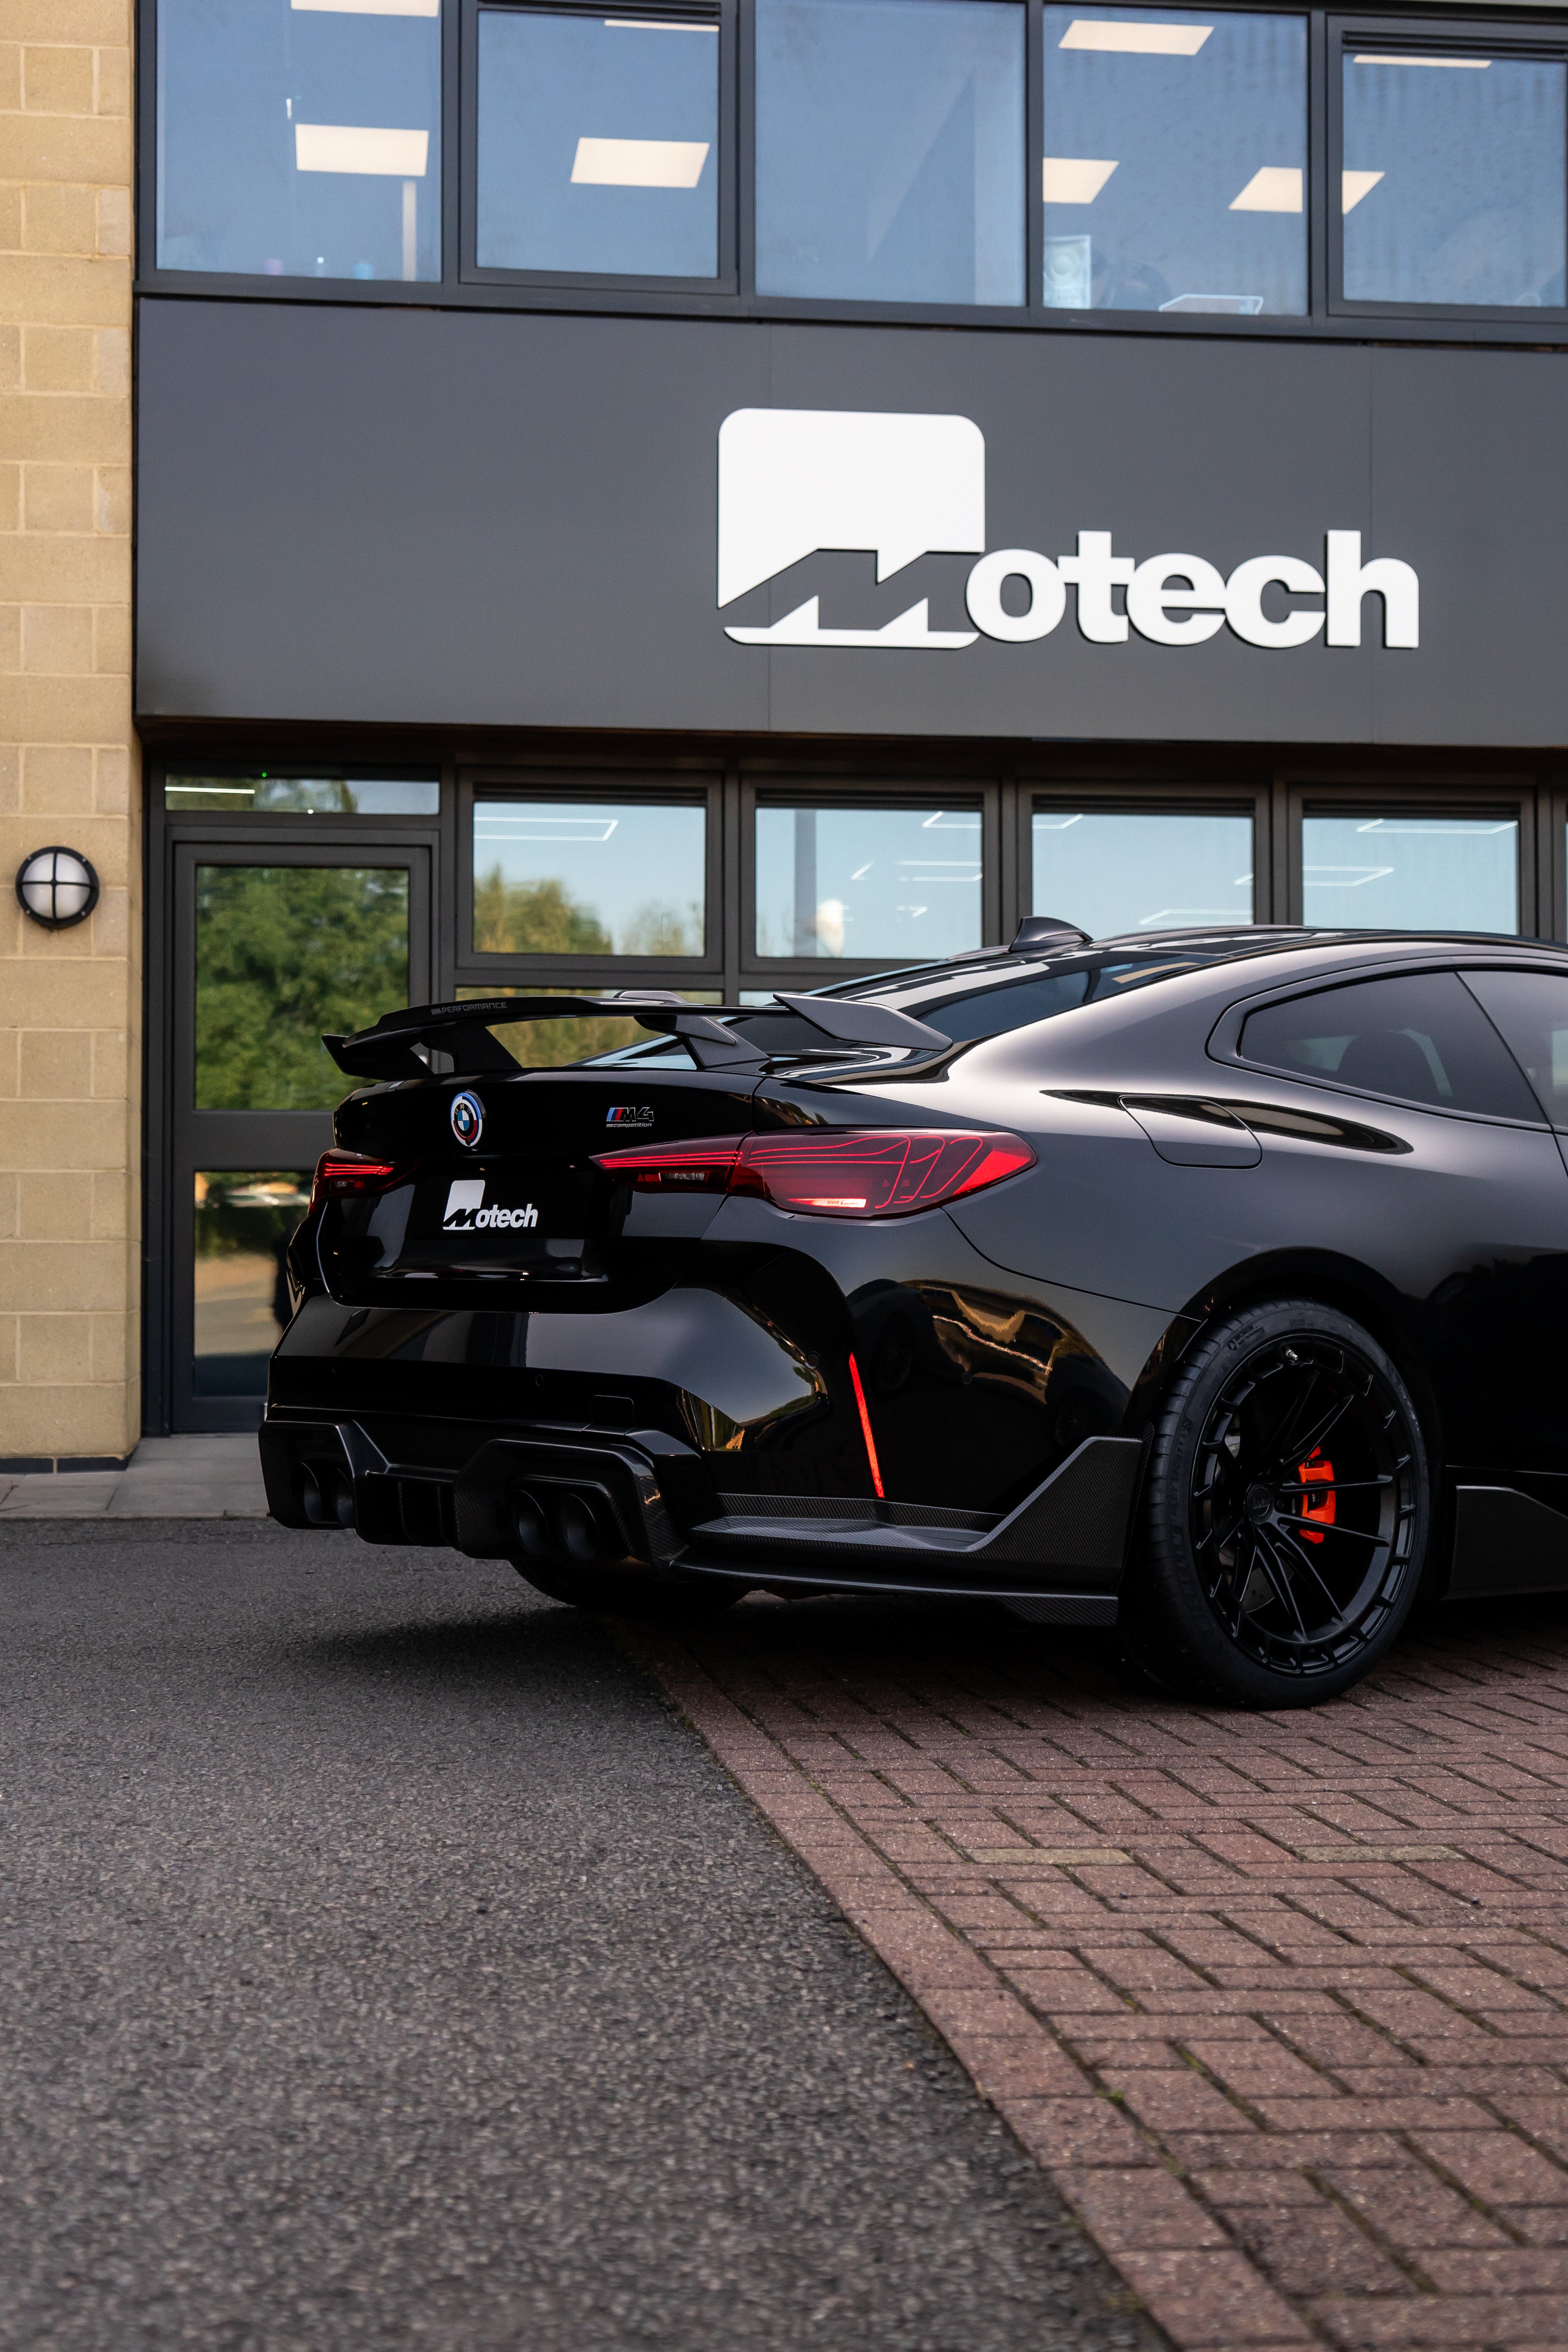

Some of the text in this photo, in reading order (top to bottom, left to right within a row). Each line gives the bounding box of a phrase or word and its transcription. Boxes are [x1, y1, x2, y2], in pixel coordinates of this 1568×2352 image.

[718, 408, 1420, 649] Motech
[441, 1002, 507, 1014] PERFORMANCE
[617, 1107, 654, 1122] M4
[443, 1180, 538, 1230] Motech
